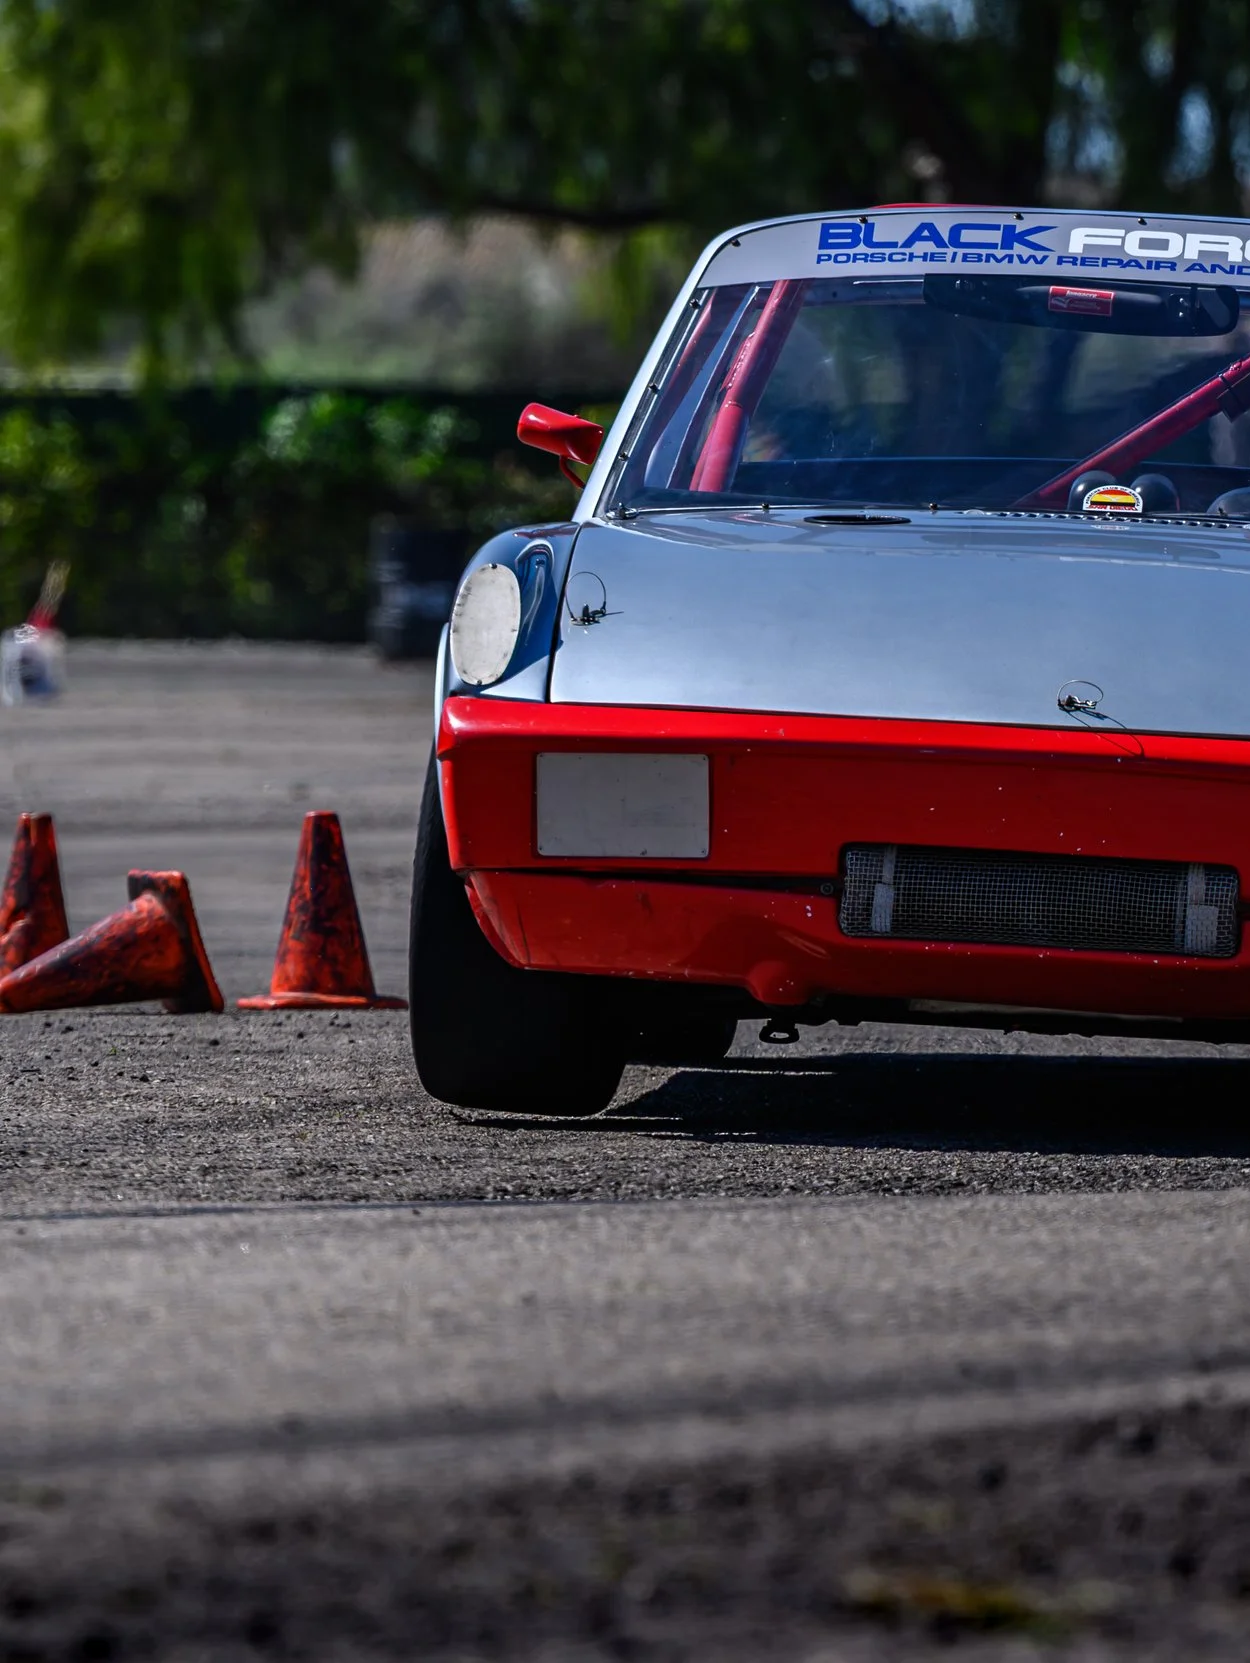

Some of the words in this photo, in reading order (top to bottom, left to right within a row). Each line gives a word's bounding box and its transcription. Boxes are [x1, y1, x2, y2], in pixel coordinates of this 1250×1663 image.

[817, 222, 1059, 252] BLACK
[816, 251, 1049, 265] PORSCHE/BMW
[1056, 255, 1177, 271] REPAIR
